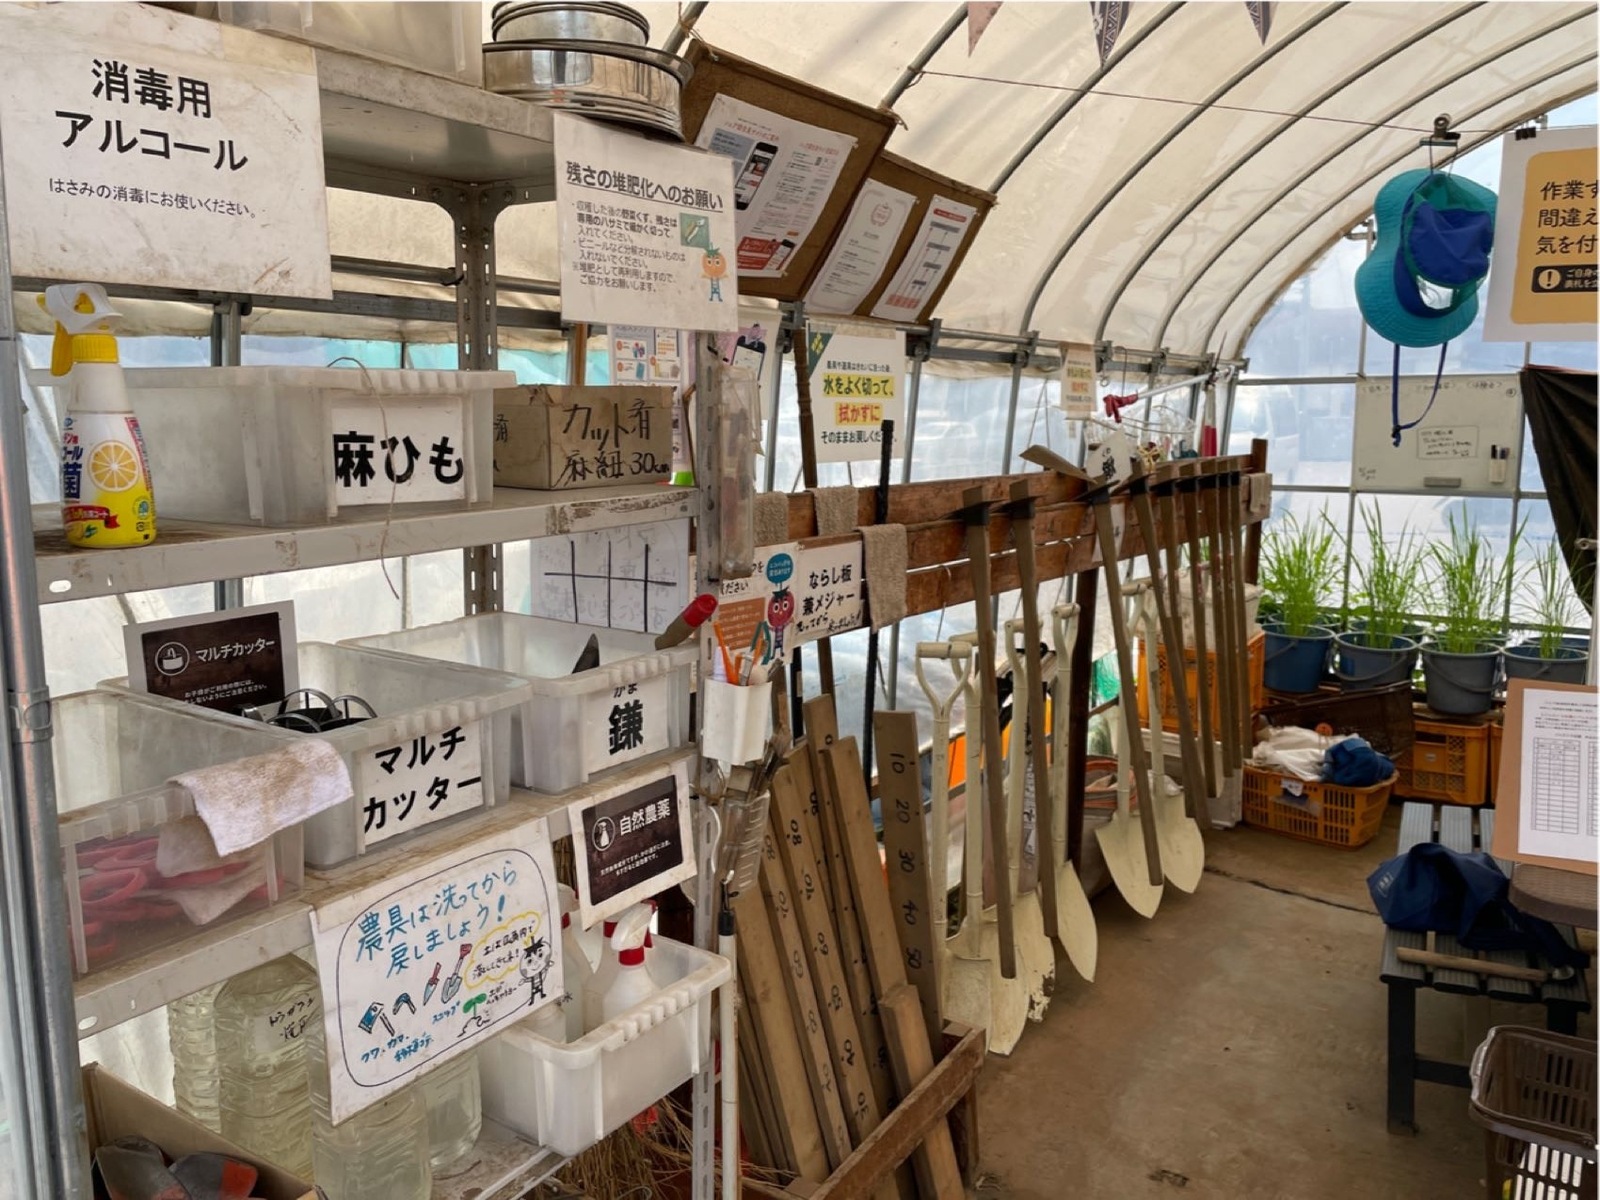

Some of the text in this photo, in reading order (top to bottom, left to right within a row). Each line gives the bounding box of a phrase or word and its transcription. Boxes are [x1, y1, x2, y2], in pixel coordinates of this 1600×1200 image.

[91, 59, 212, 118] 消毒用
[55, 110, 248, 171] アルコール
[50, 178, 256, 218] はさみの消毒にお使いください。
[566, 161, 723, 210] 残さの堆肥化へのお願い
[824, 375, 894, 396] 水をよく切って、
[333, 430, 464, 487] 麻ひも
[809, 565, 852, 589] ならし板
[196, 637, 275, 662] マルチカッター
[375, 725, 467, 775] マルチ
[609, 699, 644, 755] 鎌
[890, 752, 905, 774] 10
[363, 775, 481, 833] カッター
[620, 798, 671, 836] 自然農薬
[896, 799, 910, 824] 20
[355, 859, 517, 963] 農具は洗ってから
